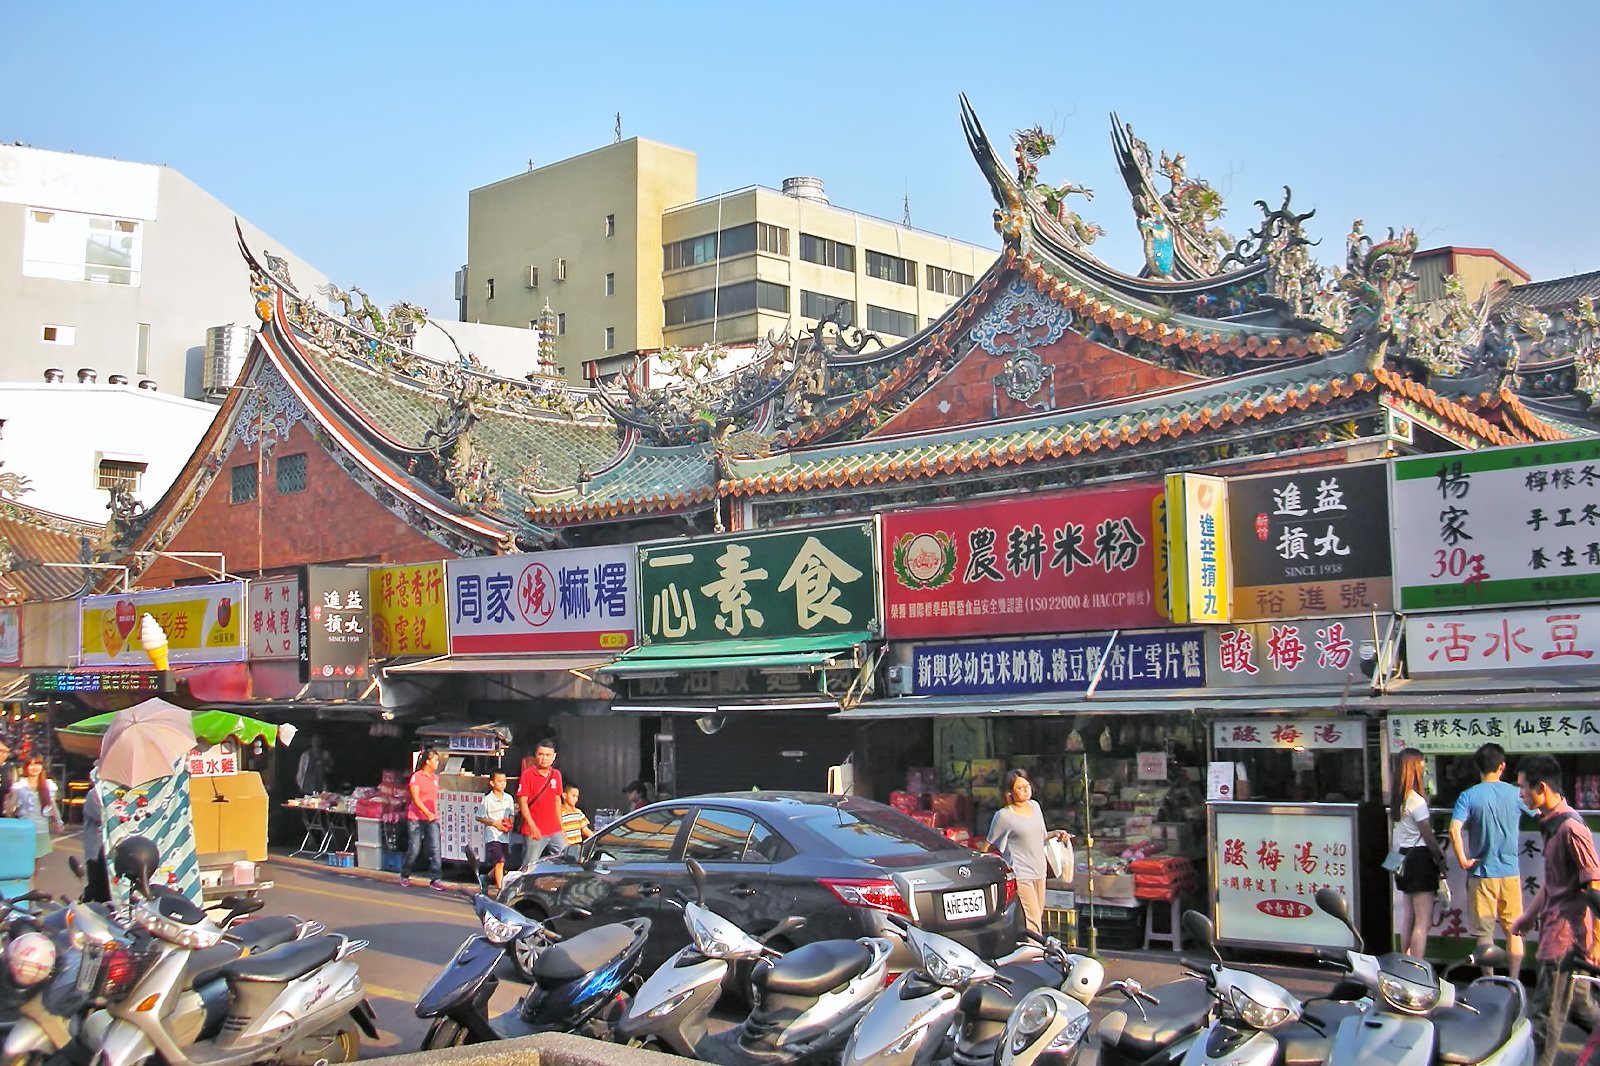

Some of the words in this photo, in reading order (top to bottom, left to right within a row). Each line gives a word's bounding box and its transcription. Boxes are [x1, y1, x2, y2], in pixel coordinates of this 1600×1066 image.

[1273, 477, 1348, 517] 進益
[1436, 461, 1473, 546] 楊家
[963, 516, 1146, 584] 農耕米粉
[1285, 563, 1317, 577] SINCE
[1319, 563, 1344, 575] 1938
[1430, 547, 1491, 592] 30年
[264, 586, 290, 604] 新竹
[323, 590, 364, 610] 進益
[380, 568, 442, 609] 得意香行
[649, 553, 697, 638] 一心
[700, 536, 864, 636] 素食
[1082, 594, 1090, 608] &
[265, 638, 291, 654] 入口
[1218, 622, 1353, 675] 酸梅湯
[1424, 614, 1594, 662] 活水豆
[1232, 723, 1343, 744] 酸梅湯
[1223, 838, 1319, 876] 酸梅湯
